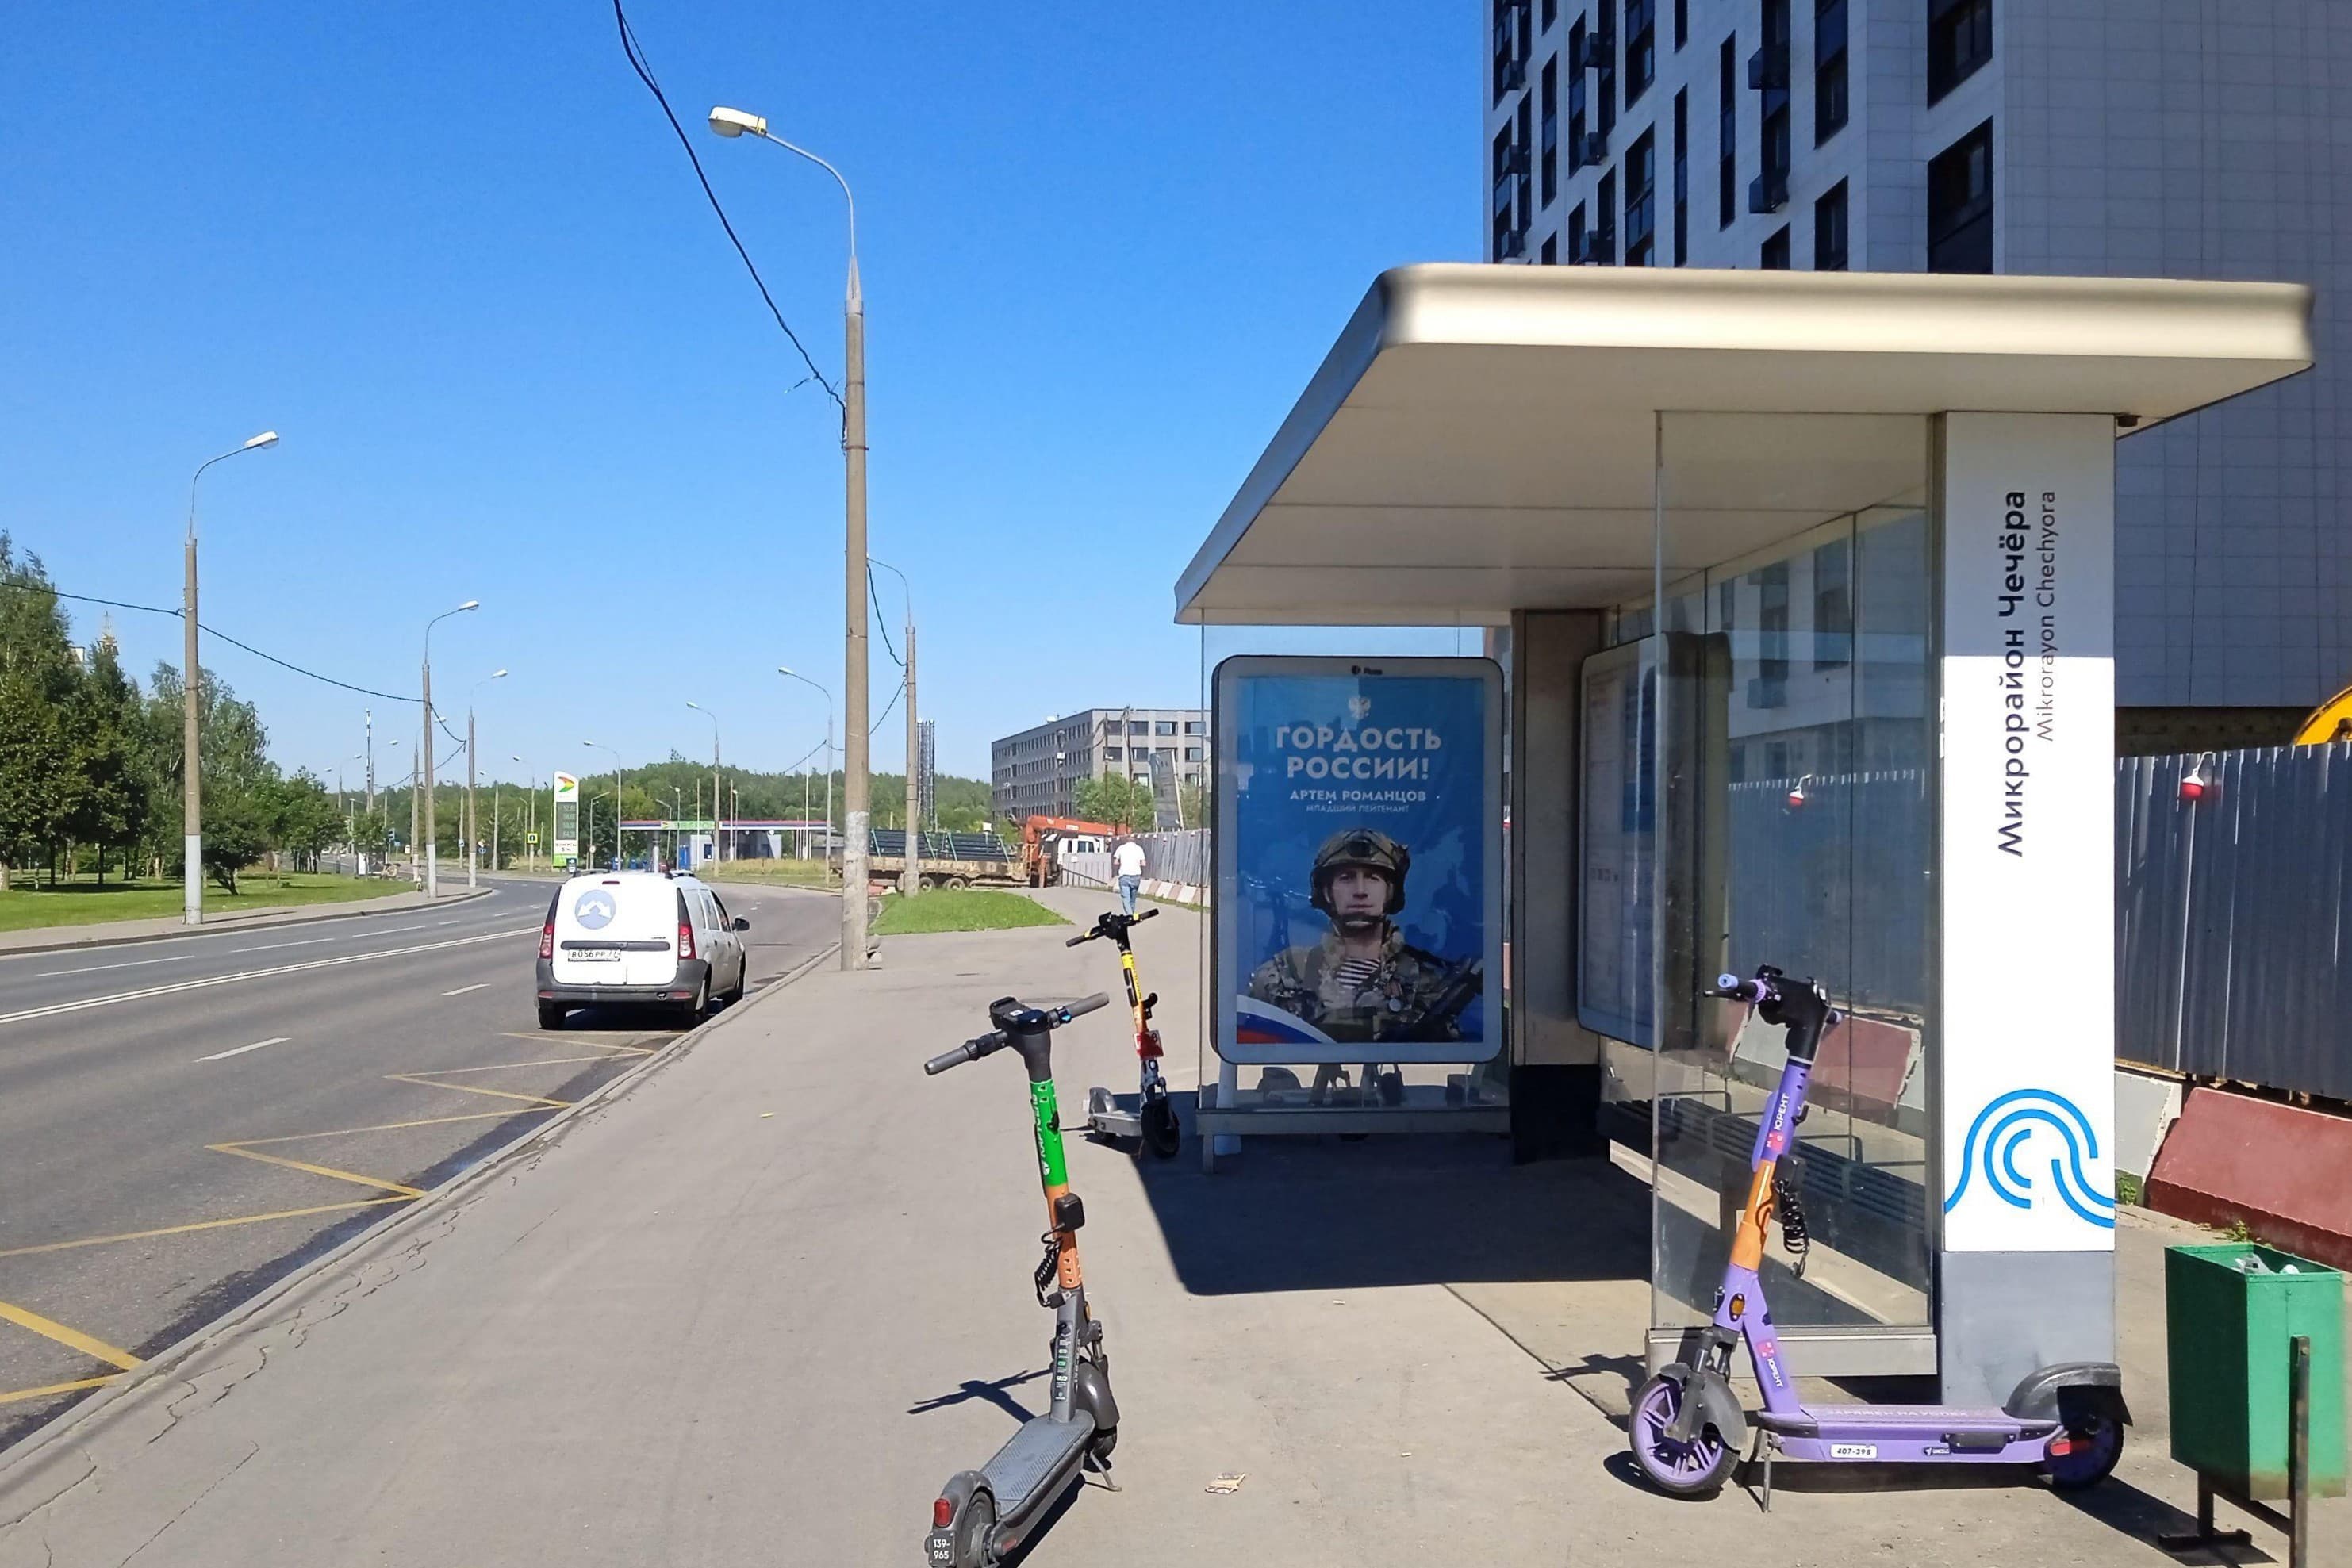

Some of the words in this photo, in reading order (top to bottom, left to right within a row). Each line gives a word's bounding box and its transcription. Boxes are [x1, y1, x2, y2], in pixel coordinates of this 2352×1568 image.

[1998, 491, 2031, 617] Чечёра
[2035, 492, 2059, 608] Chechyora
[2035, 615, 2058, 742] Mikrorayon
[1276, 726, 1441, 752] ГОРДОСТЬ
[1998, 630, 2030, 857] Микрорайон
[1287, 756, 1429, 780] РОССИИ!
[1290, 789, 1337, 800] АРТЕМ
[1342, 790, 1426, 803] РОМАНЦОВ
[1773, 1093, 1790, 1131] ЮРЕНТ
[933, 1539, 951, 1549] 139-
[933, 1550, 950, 1560] 965
